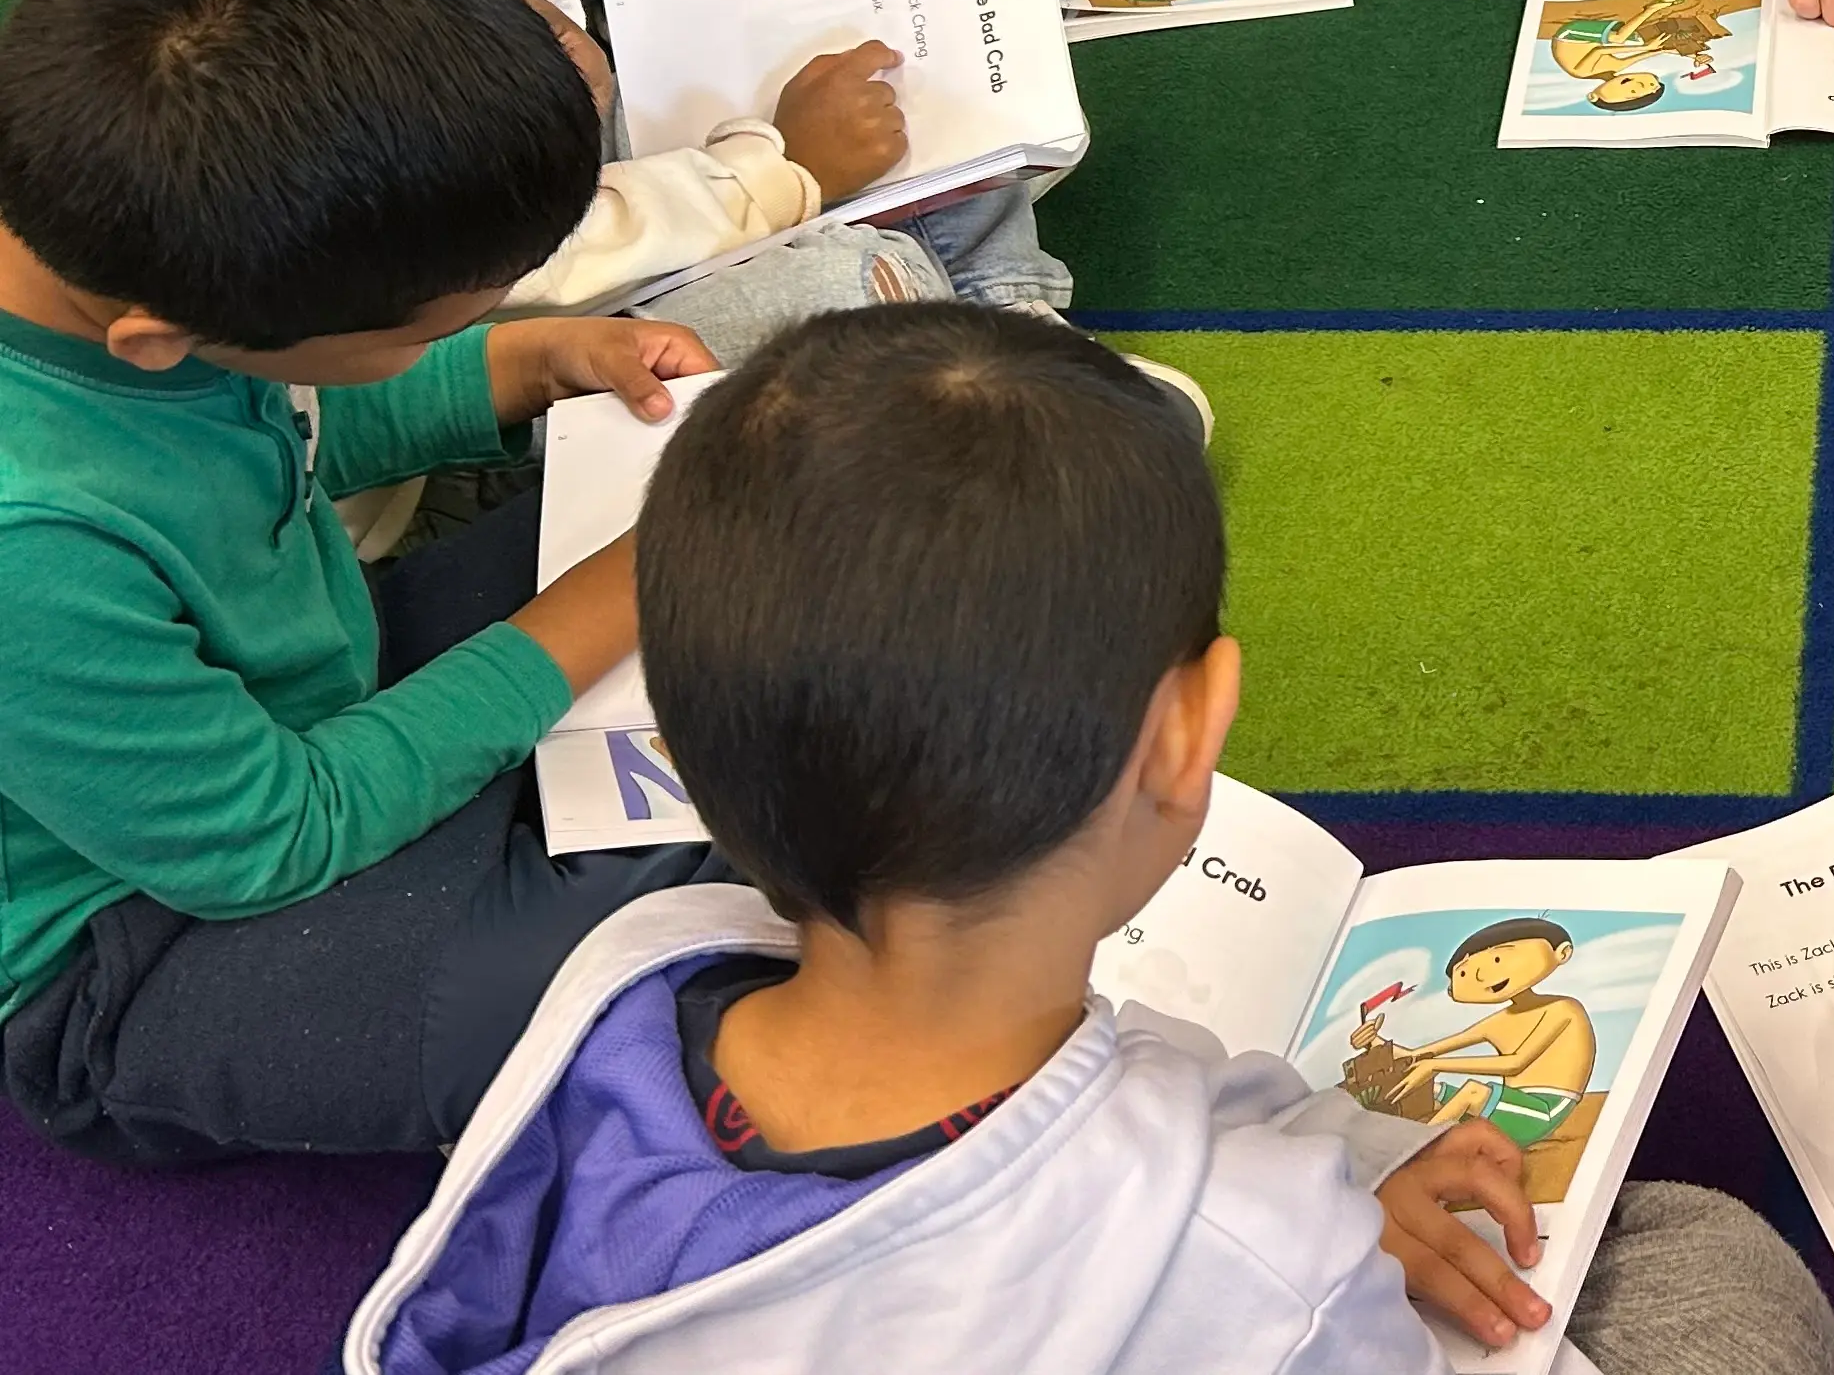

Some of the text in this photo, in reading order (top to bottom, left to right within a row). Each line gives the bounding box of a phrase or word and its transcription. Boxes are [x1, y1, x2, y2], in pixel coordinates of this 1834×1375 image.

[912, 14, 928, 61] Chang.
[978, 10, 1001, 45] Bad
[986, 49, 1008, 94] Crab
[1201, 856, 1267, 902] Crab
[1779, 875, 1826, 898] The
[1748, 958, 1783, 976] This
[1784, 954, 1799, 967] is
[1765, 986, 1809, 1009] Zack
[1809, 982, 1824, 995] is
